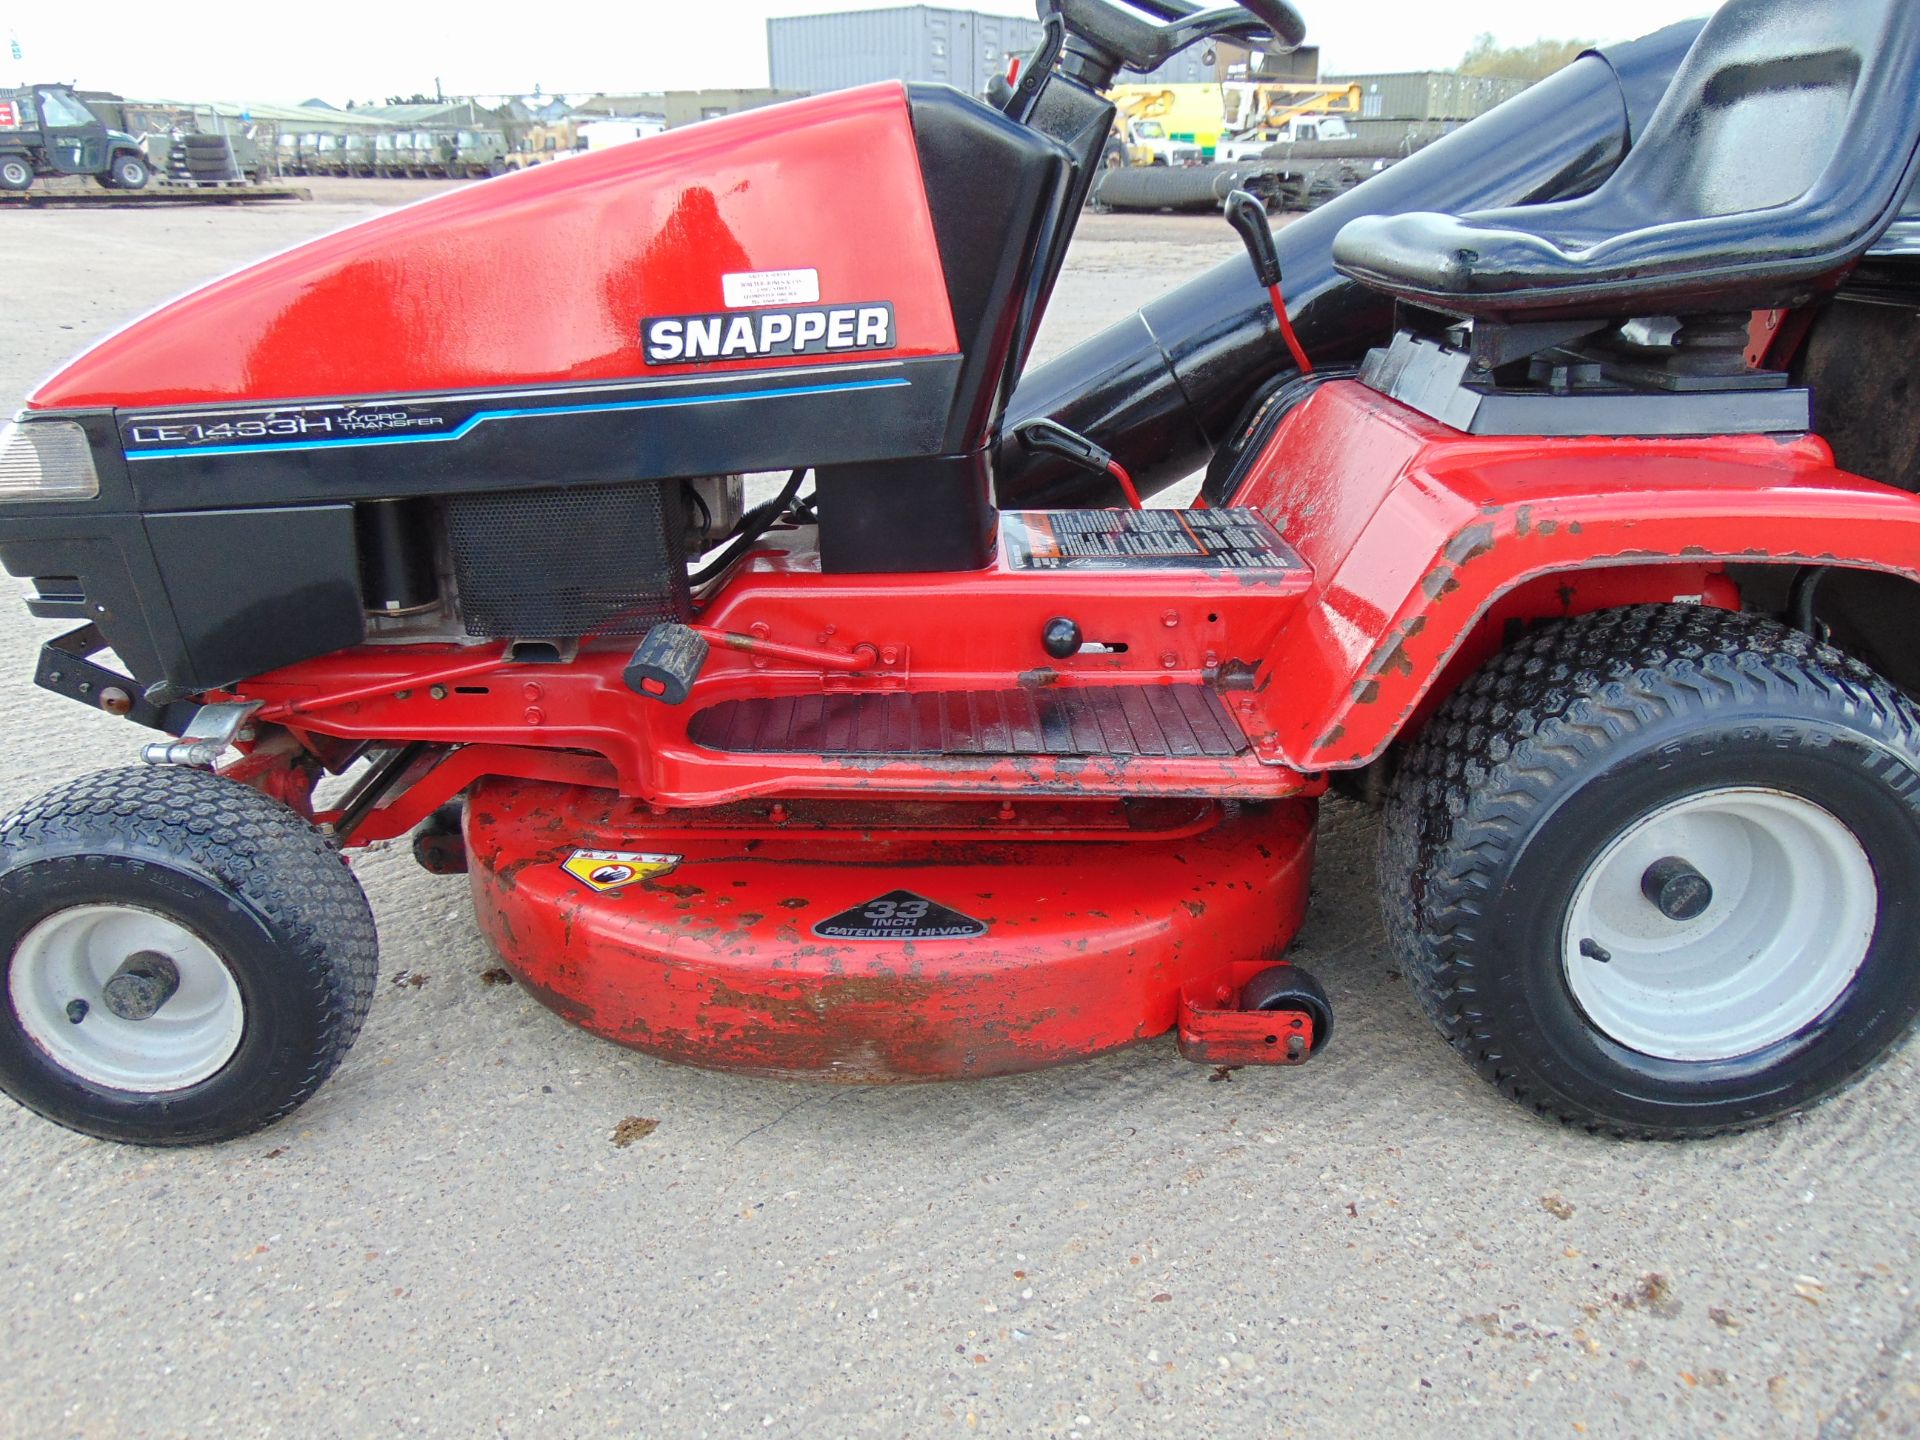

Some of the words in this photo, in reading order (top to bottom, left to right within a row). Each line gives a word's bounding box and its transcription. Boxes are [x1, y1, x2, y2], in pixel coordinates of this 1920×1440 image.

[649, 306, 889, 360] SNAPPER
[337, 412, 407, 423] HYDRO
[340, 417, 443, 430] TRANSFER
[864, 901, 929, 919] 33
[872, 918, 918, 927] INCH
[825, 926, 914, 937] PATENTED
[918, 925, 973, 937] HI-VAC
